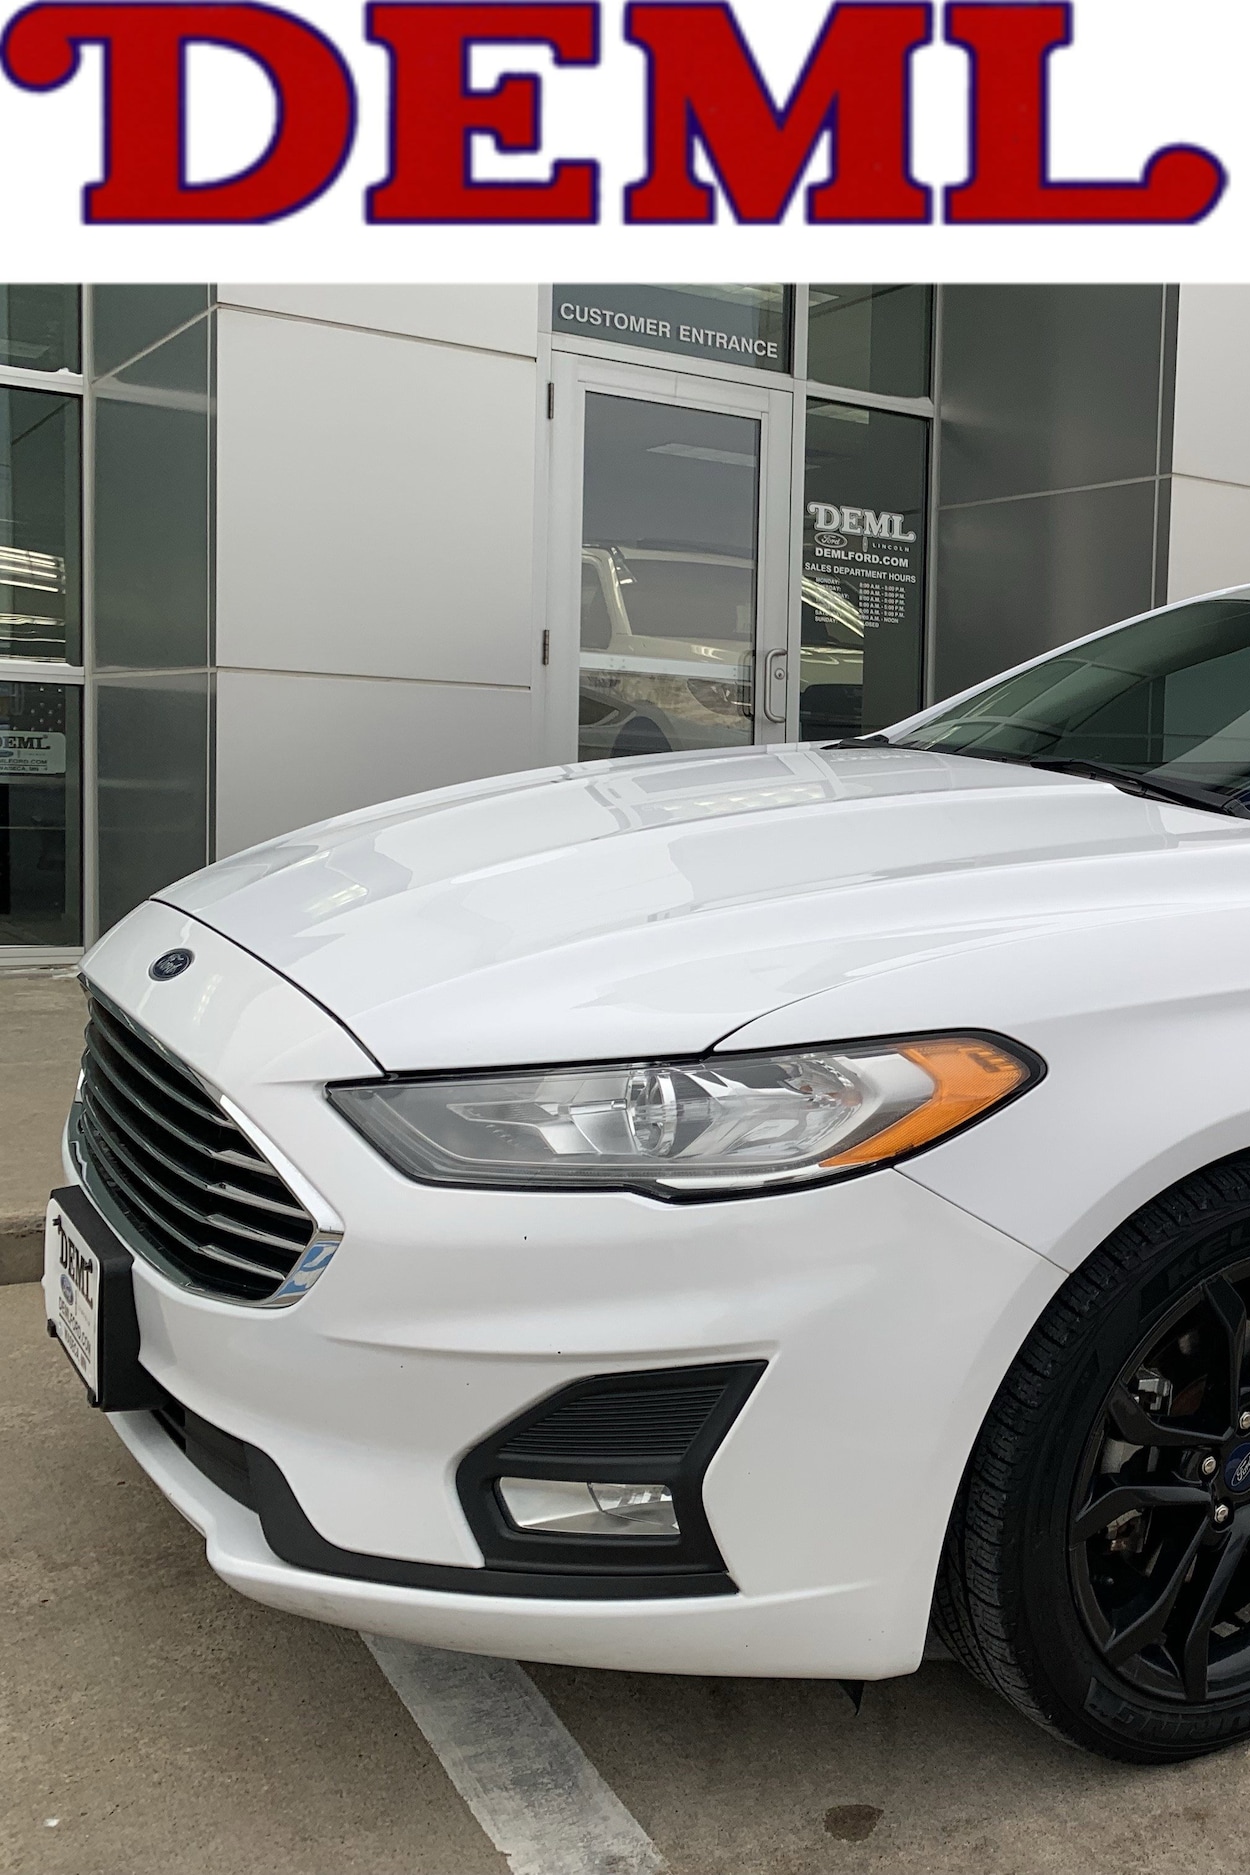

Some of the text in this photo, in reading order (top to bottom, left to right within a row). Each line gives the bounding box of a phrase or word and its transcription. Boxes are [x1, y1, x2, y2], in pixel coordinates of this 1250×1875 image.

[560, 302, 778, 358] CUSTOMER ENTRANCE
[807, 501, 917, 542] DEML
[820, 534, 842, 546] Ford
[872, 542, 910, 553] LINCOLN
[815, 547, 909, 568] DEMLFORD.COM
[804, 562, 916, 584] SALES DEPARTMENT HOURS
[0, 736, 51, 750] EML
[58, 1223, 94, 1310] DEML
